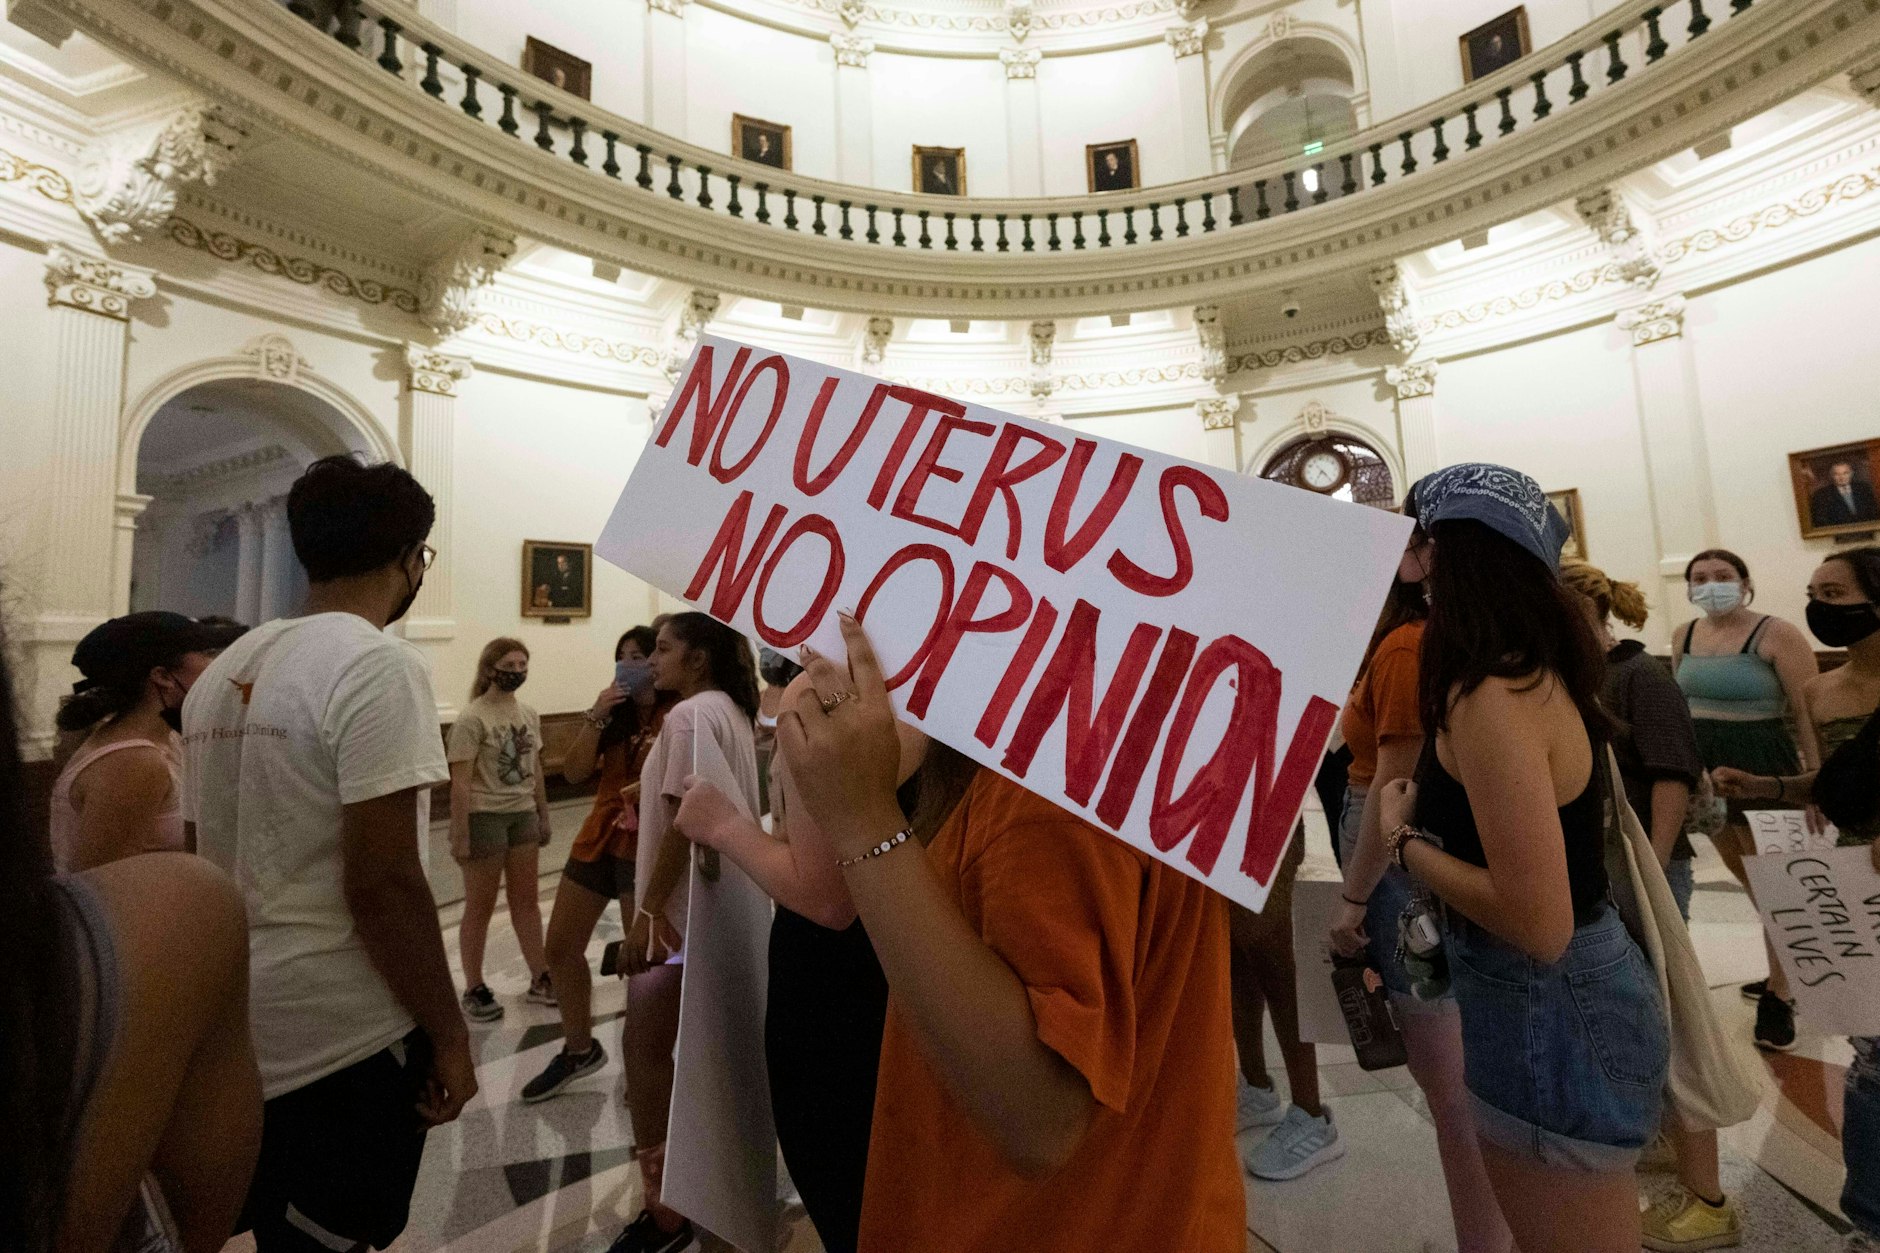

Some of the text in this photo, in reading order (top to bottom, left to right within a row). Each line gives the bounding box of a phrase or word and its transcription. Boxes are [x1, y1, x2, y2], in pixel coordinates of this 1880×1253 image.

[654, 345, 1229, 598] NO UTERUS
[684, 490, 1339, 887] NO OPINION
[1771, 908, 1846, 987] LIVES
[1787, 858, 1873, 957] CERTAIN
